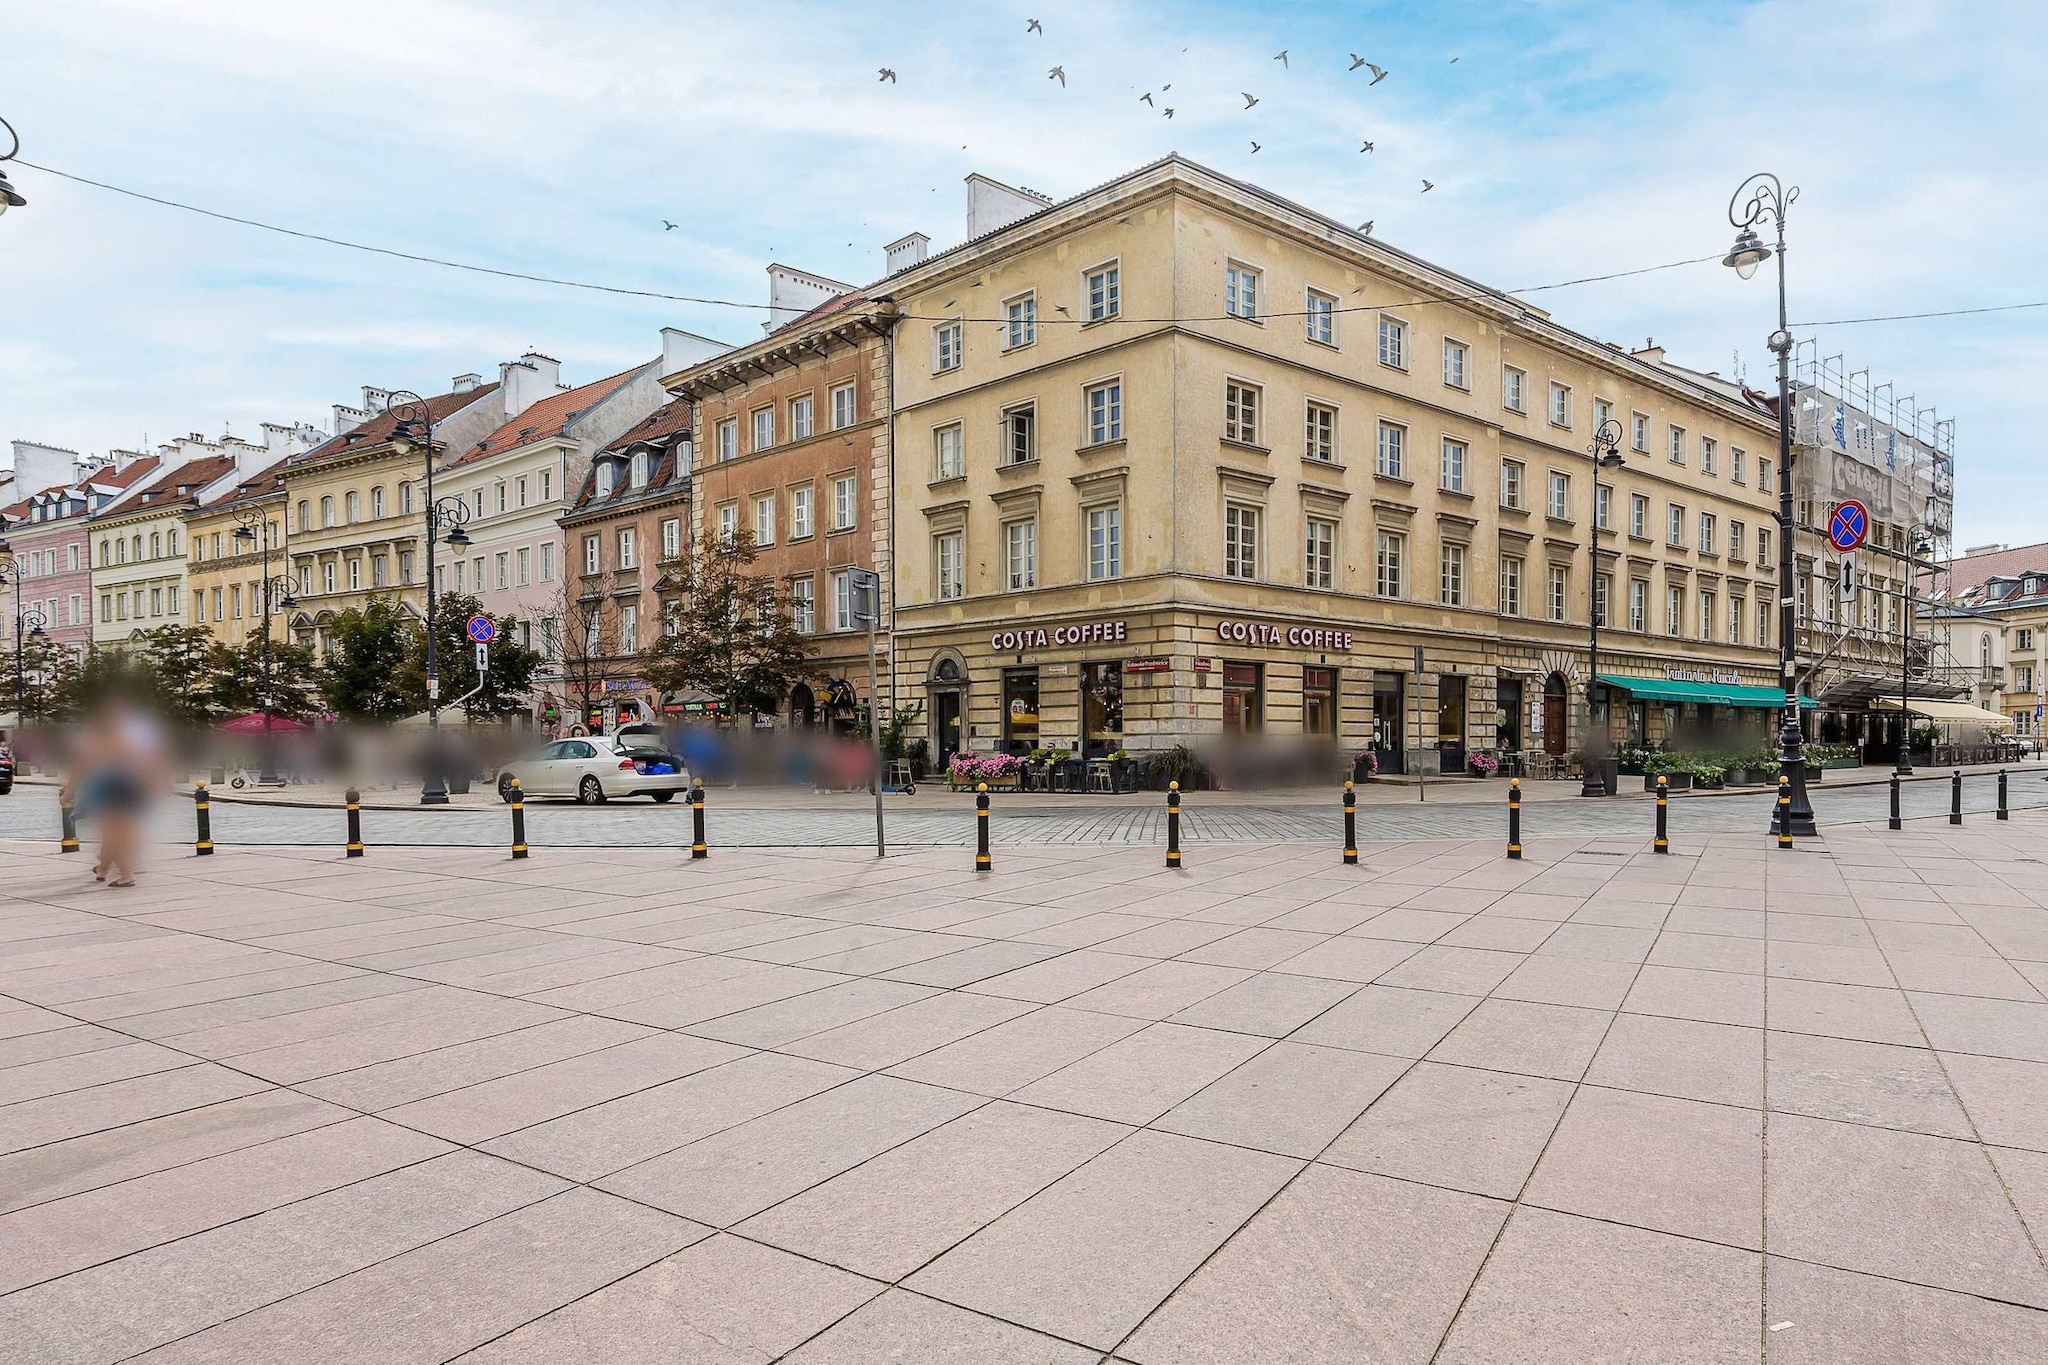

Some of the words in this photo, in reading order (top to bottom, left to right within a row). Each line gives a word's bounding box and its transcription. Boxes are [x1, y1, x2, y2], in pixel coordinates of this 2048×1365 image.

[991, 629, 1047, 650] COSTA
[1055, 621, 1125, 645] COFFEE
[1218, 621, 1281, 644] COSTA
[1288, 627, 1352, 649] COFFEE
